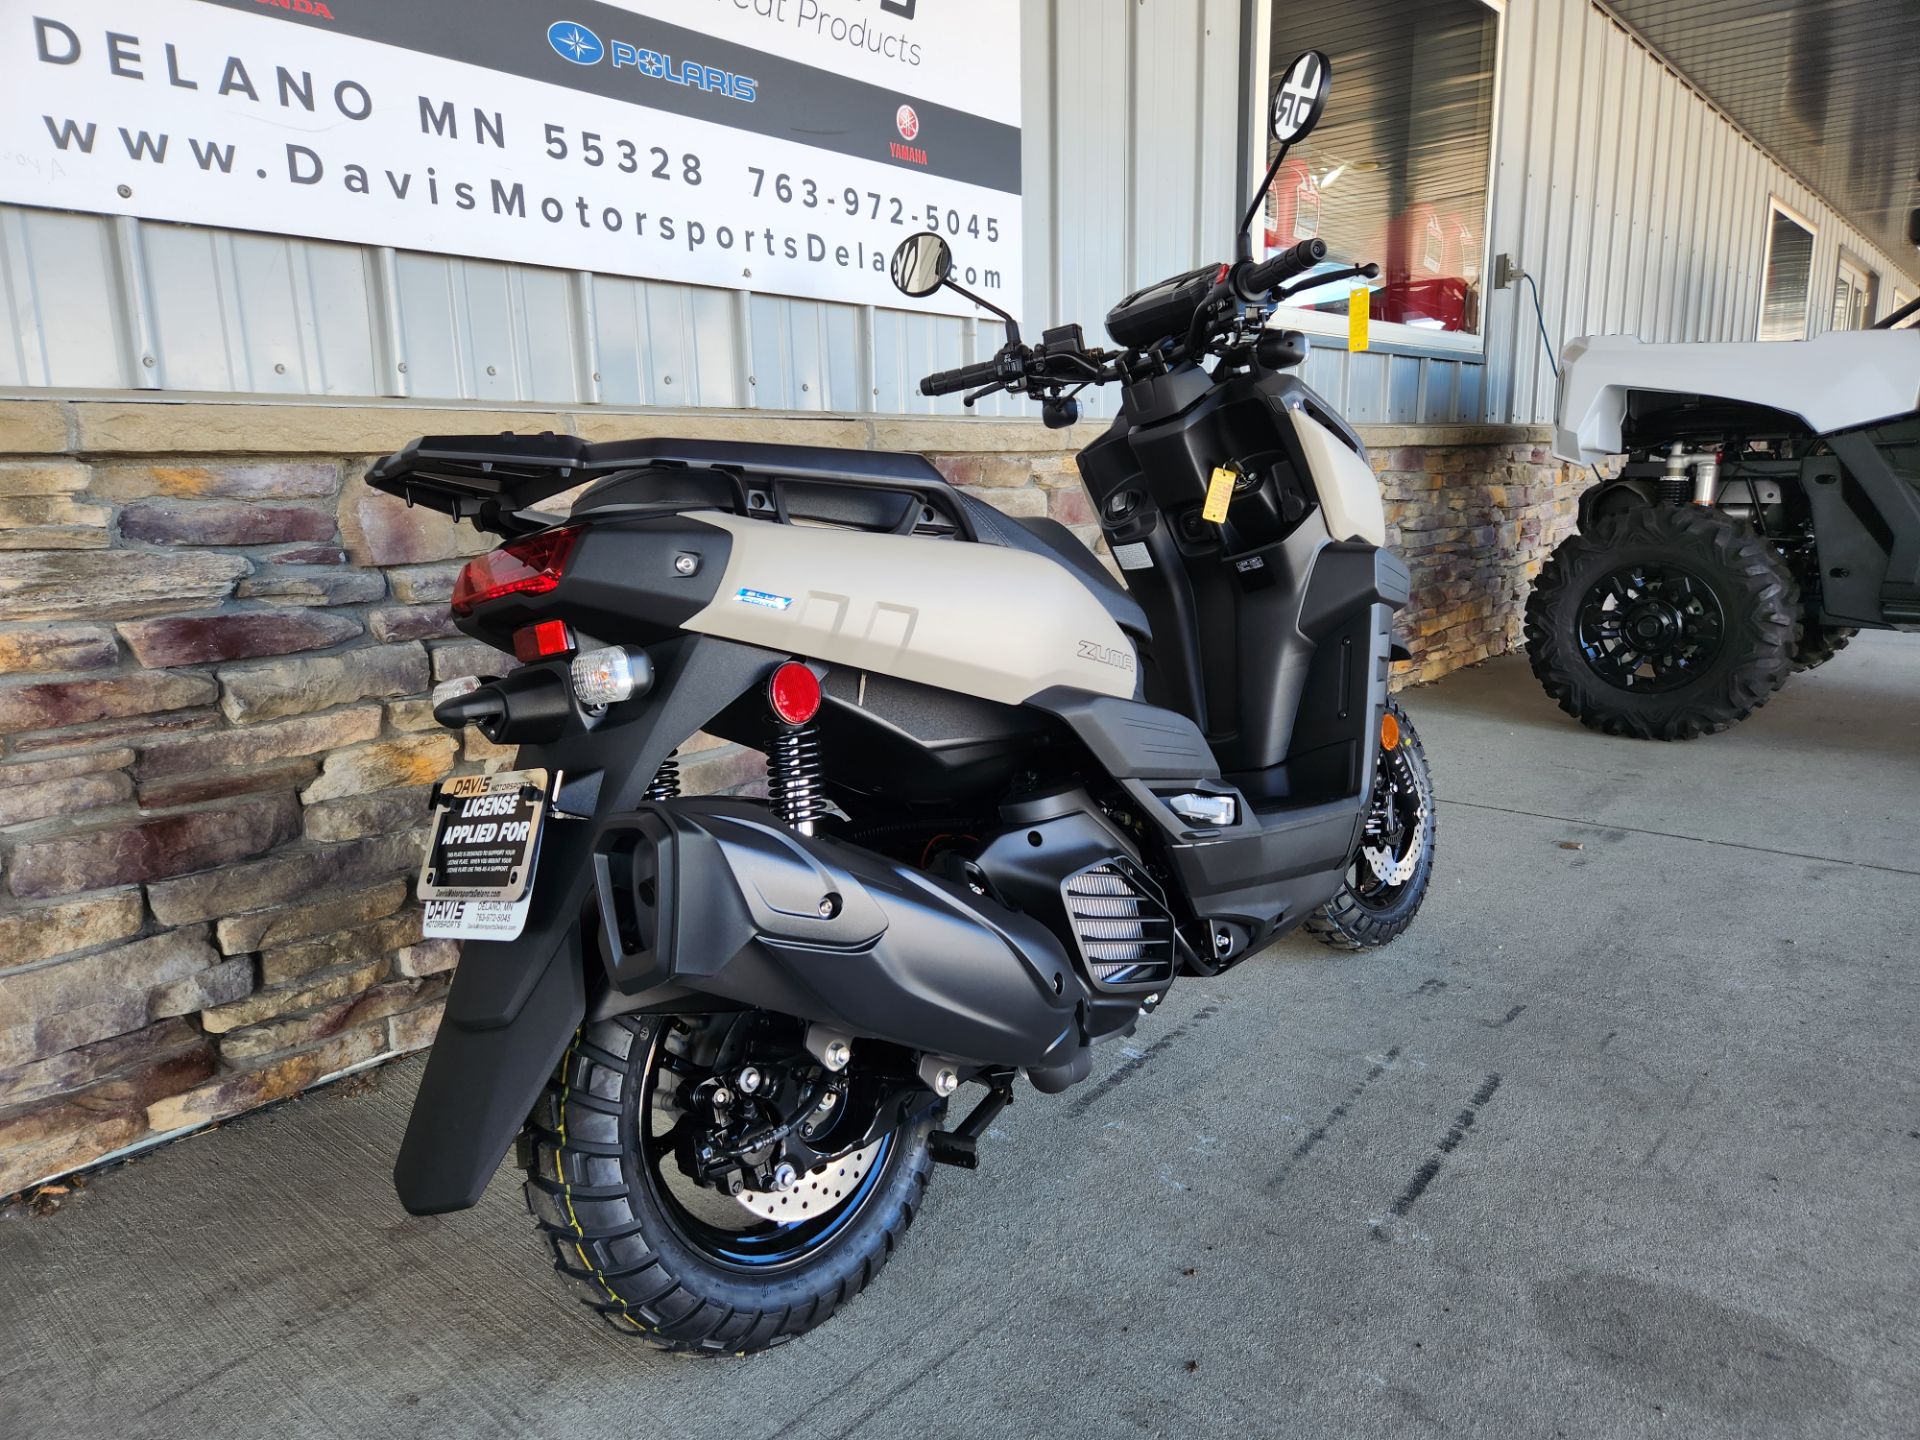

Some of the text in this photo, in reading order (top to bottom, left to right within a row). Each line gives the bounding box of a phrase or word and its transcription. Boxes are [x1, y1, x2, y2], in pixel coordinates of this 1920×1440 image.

[798, 0, 922, 66] Products
[611, 39, 757, 103] POLARIS
[33, 16, 1000, 243] DELANO MN 55328 763-972-5045
[889, 142, 929, 166] YAMAHA
[43, 115, 1001, 289] www.DavisMotorsportsDelacom
[1077, 640, 1134, 672] ZUMA
[454, 777, 492, 796] DAVIS
[461, 795, 519, 818] LICENSE
[442, 821, 530, 845] APPLIED FOR
[427, 901, 466, 920] DAVIS
[503, 901, 514, 911] MN
